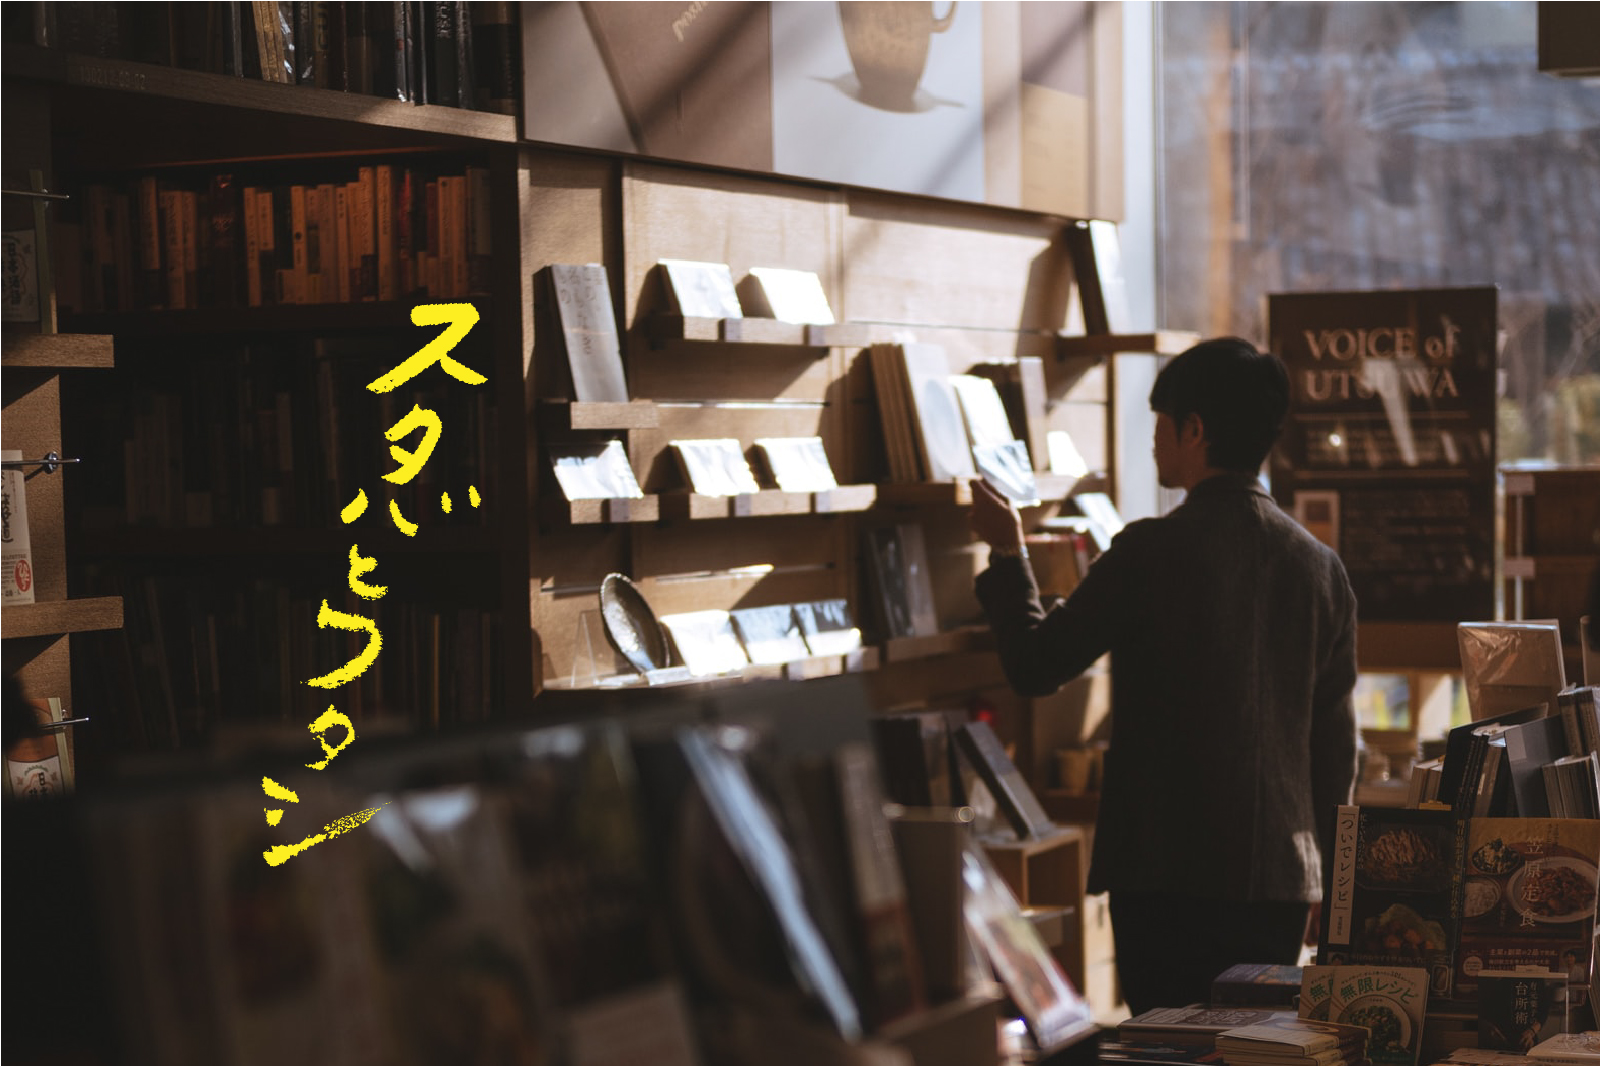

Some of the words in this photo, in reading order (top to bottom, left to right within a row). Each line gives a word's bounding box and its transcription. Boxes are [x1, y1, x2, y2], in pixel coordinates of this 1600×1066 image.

[1304, 328, 1416, 360] VOICE
[1425, 324, 1461, 359] of
[1306, 367, 1459, 401] UTWA
[1519, 836, 1544, 928] 笠原定食
[1340, 976, 1418, 1004] 無限レシピ
[1513, 981, 1528, 1025] 台所術
